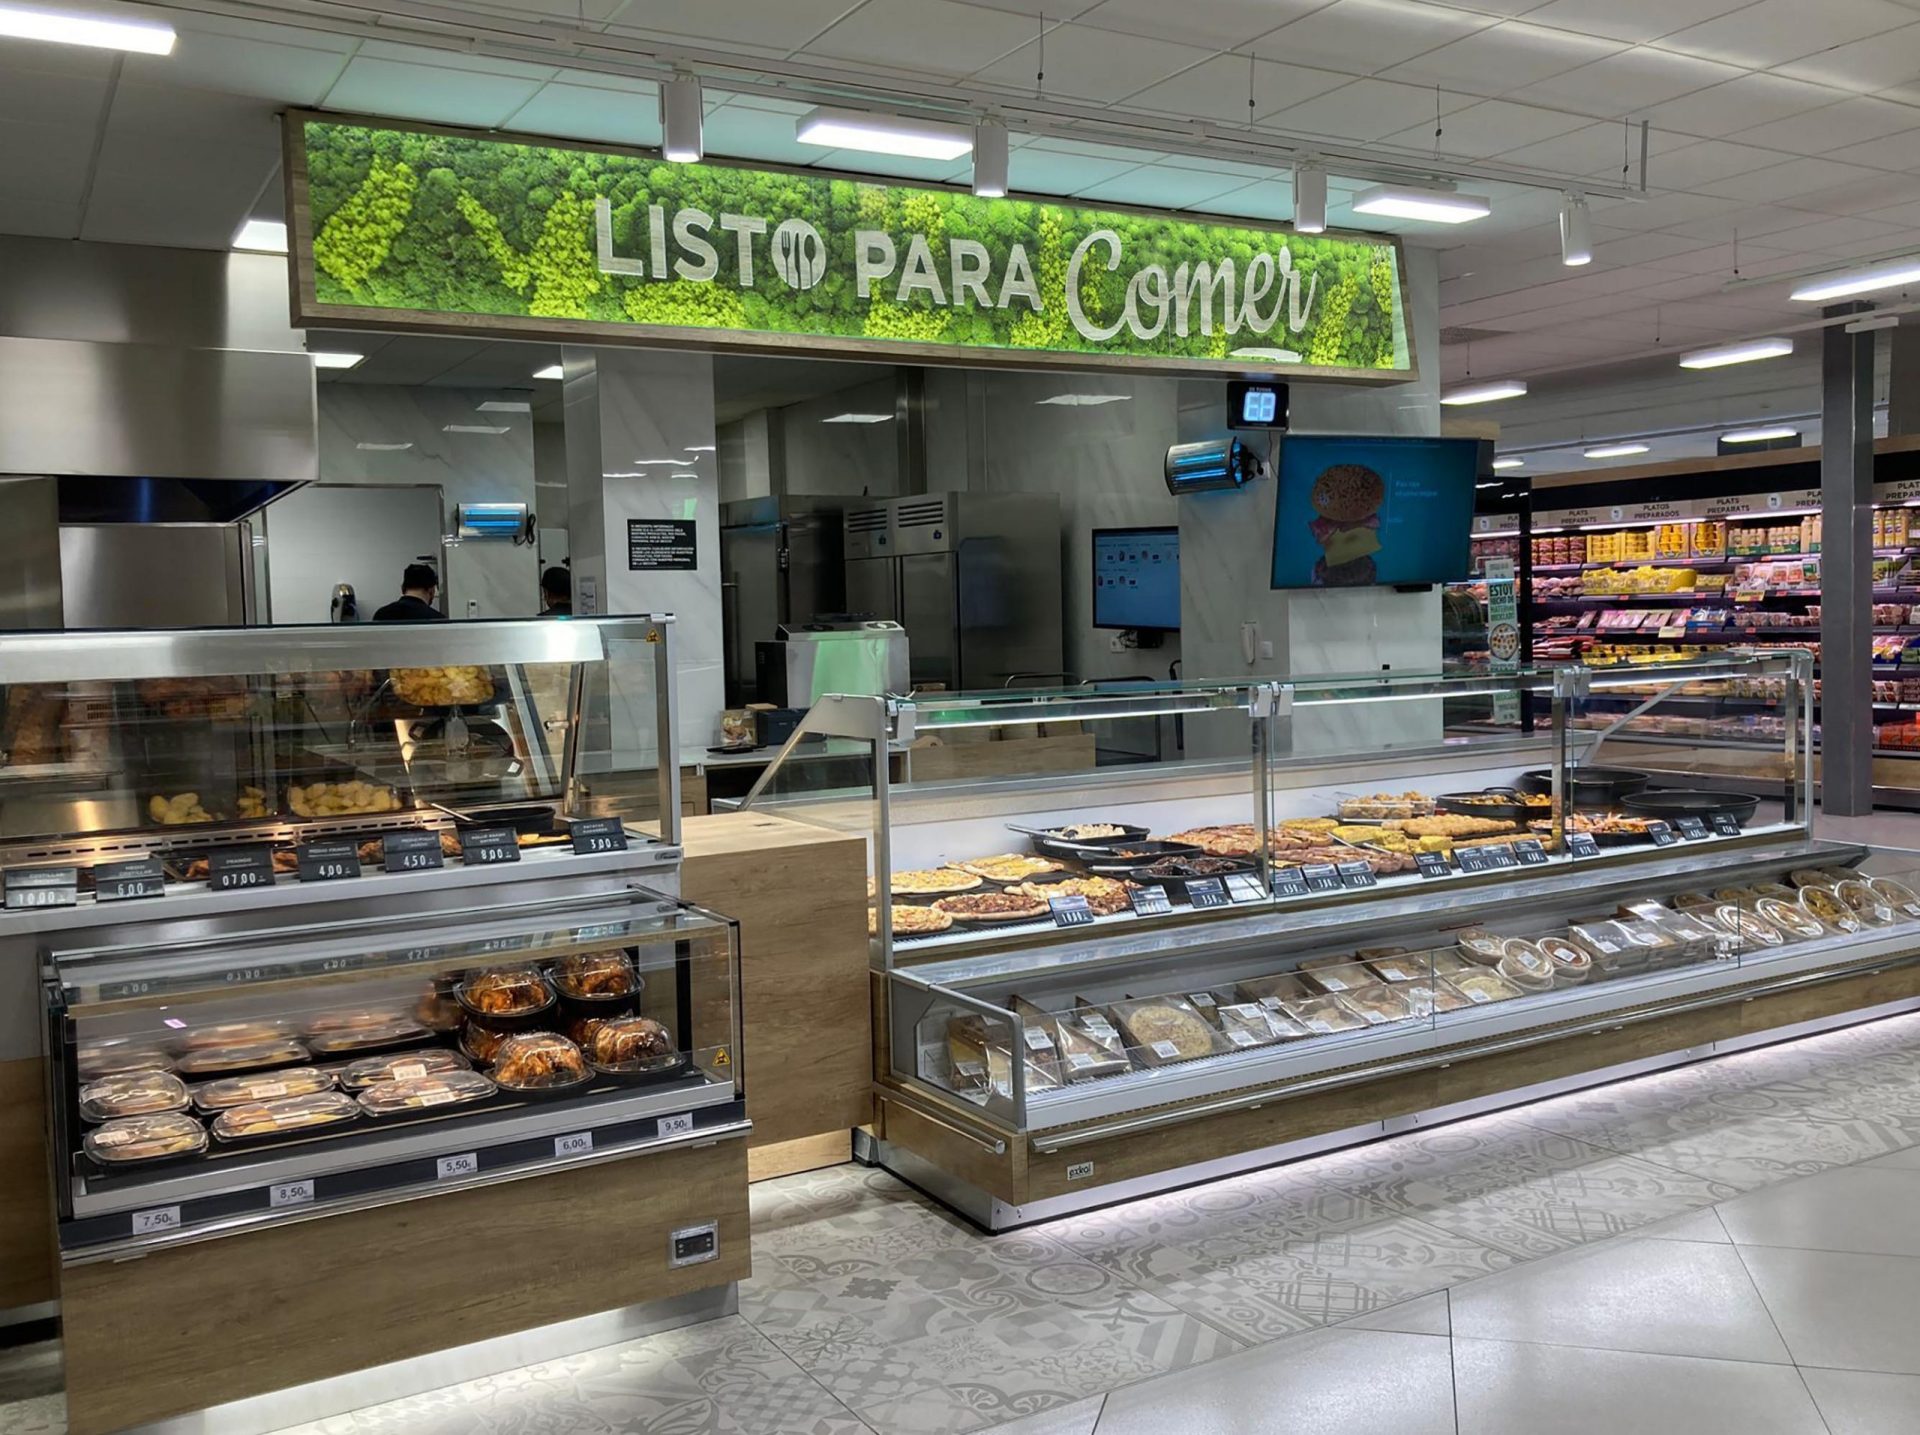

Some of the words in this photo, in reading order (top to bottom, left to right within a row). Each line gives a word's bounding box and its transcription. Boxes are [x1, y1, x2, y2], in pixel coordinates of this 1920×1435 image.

[595, 198, 826, 290] LISTO
[855, 230, 1044, 311] PARA
[1065, 230, 1318, 341] Comer
[1886, 490, 1920, 499] PREPAR
[1717, 497, 1740, 505] PLATS
[1489, 584, 1513, 597] ESTOY
